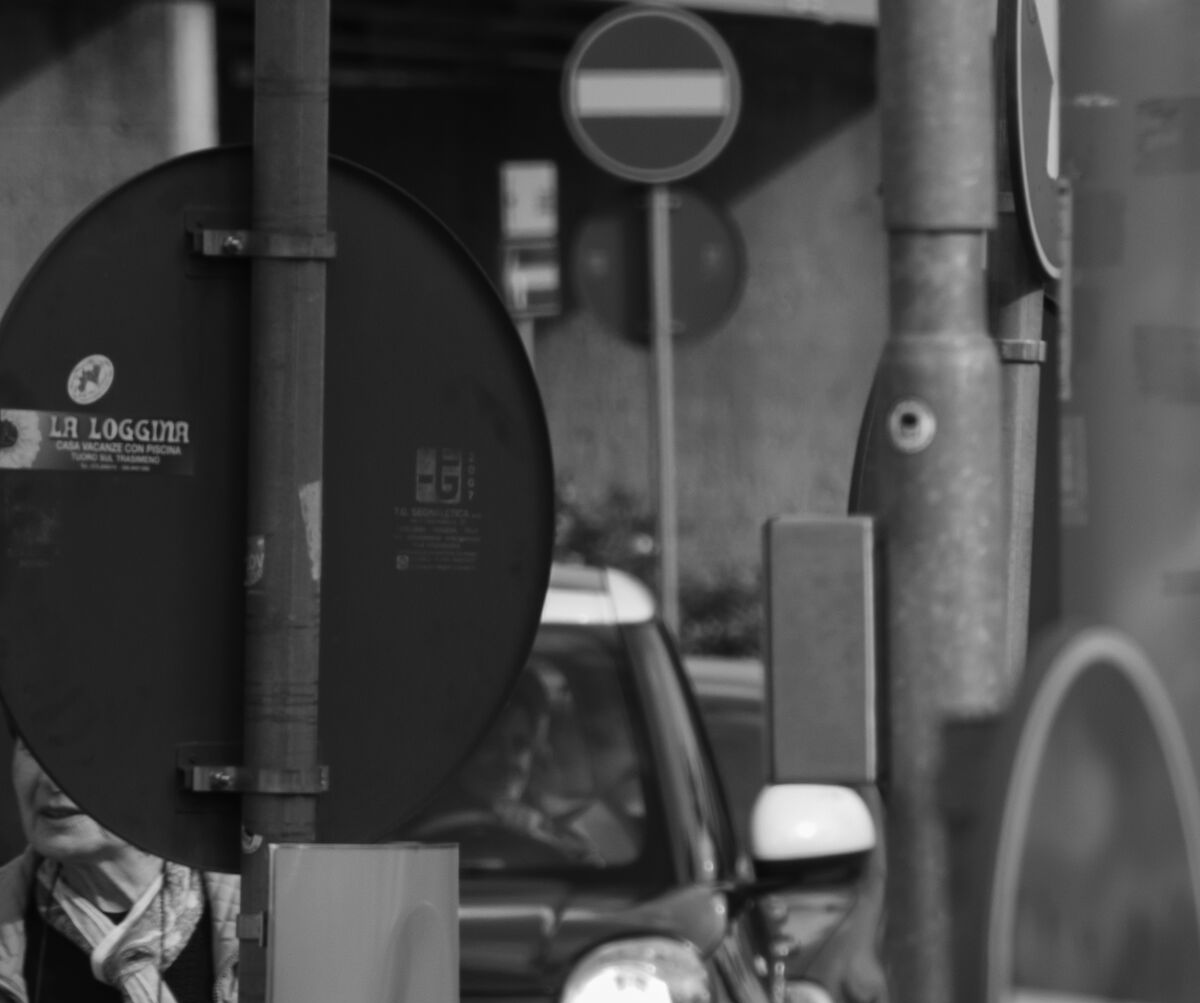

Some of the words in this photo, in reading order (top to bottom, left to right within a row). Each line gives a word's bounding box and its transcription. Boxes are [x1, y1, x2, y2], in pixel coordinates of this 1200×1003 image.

[49, 415, 79, 439] LA
[89, 417, 190, 444] LOGGINA
[56, 440, 81, 452] CASA
[82, 441, 122, 454] VACANZE
[124, 442, 144, 454] CON
[146, 443, 182, 456] PISCINA
